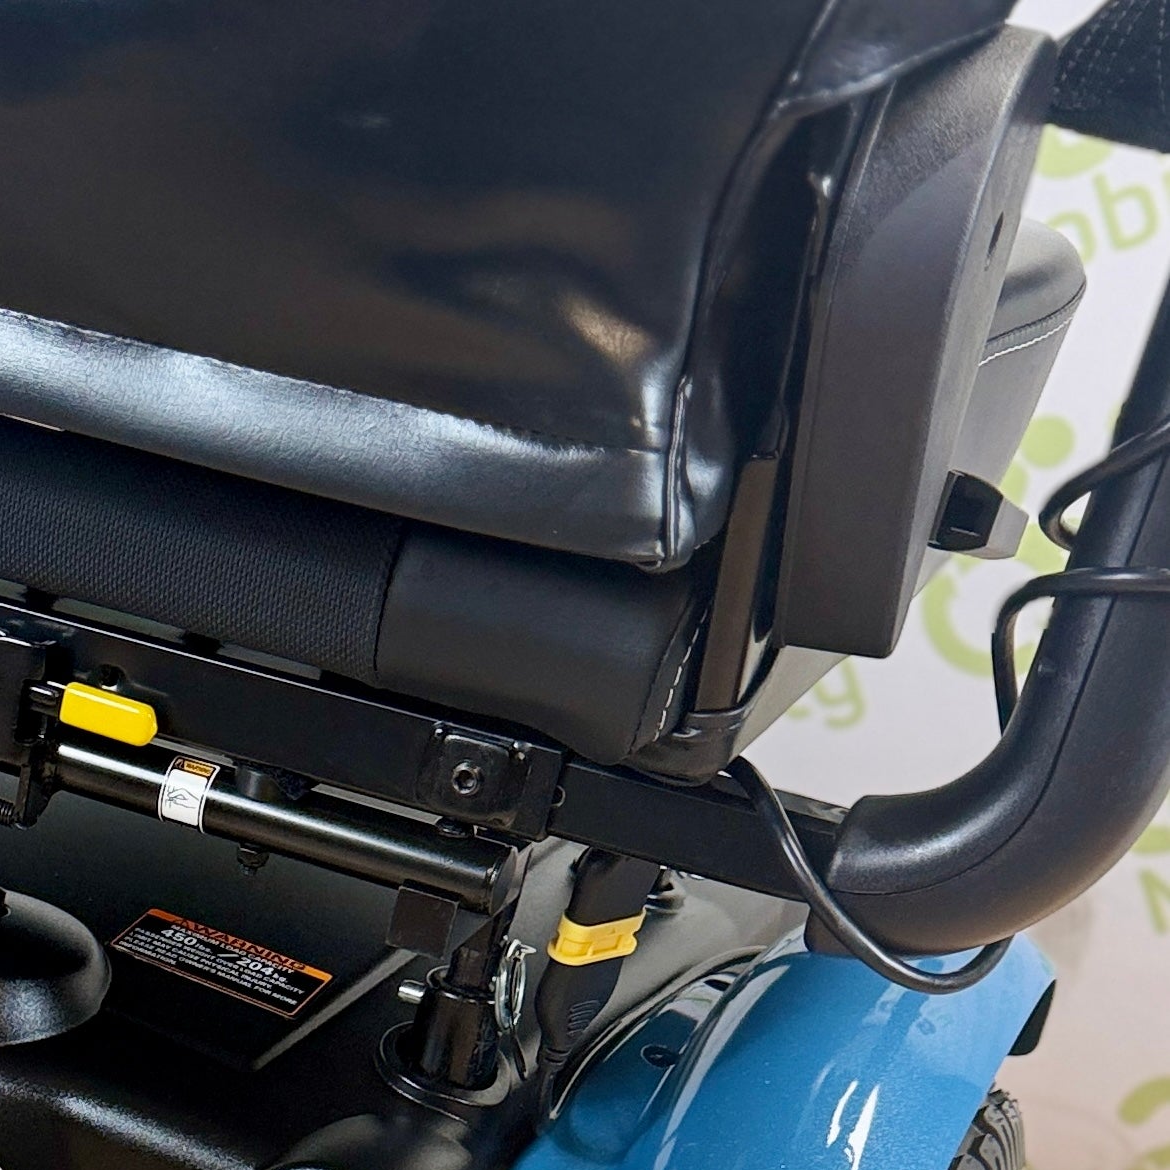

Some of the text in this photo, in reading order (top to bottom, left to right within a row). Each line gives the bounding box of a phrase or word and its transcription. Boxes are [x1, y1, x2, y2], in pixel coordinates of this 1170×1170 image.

[160, 928, 198, 946] 450
[234, 956, 275, 977] 204
[170, 924, 294, 973] MAXIMUM LOAD CAPACITY
[188, 923, 306, 971] WARNING
[262, 976, 304, 994] CAPACITY
